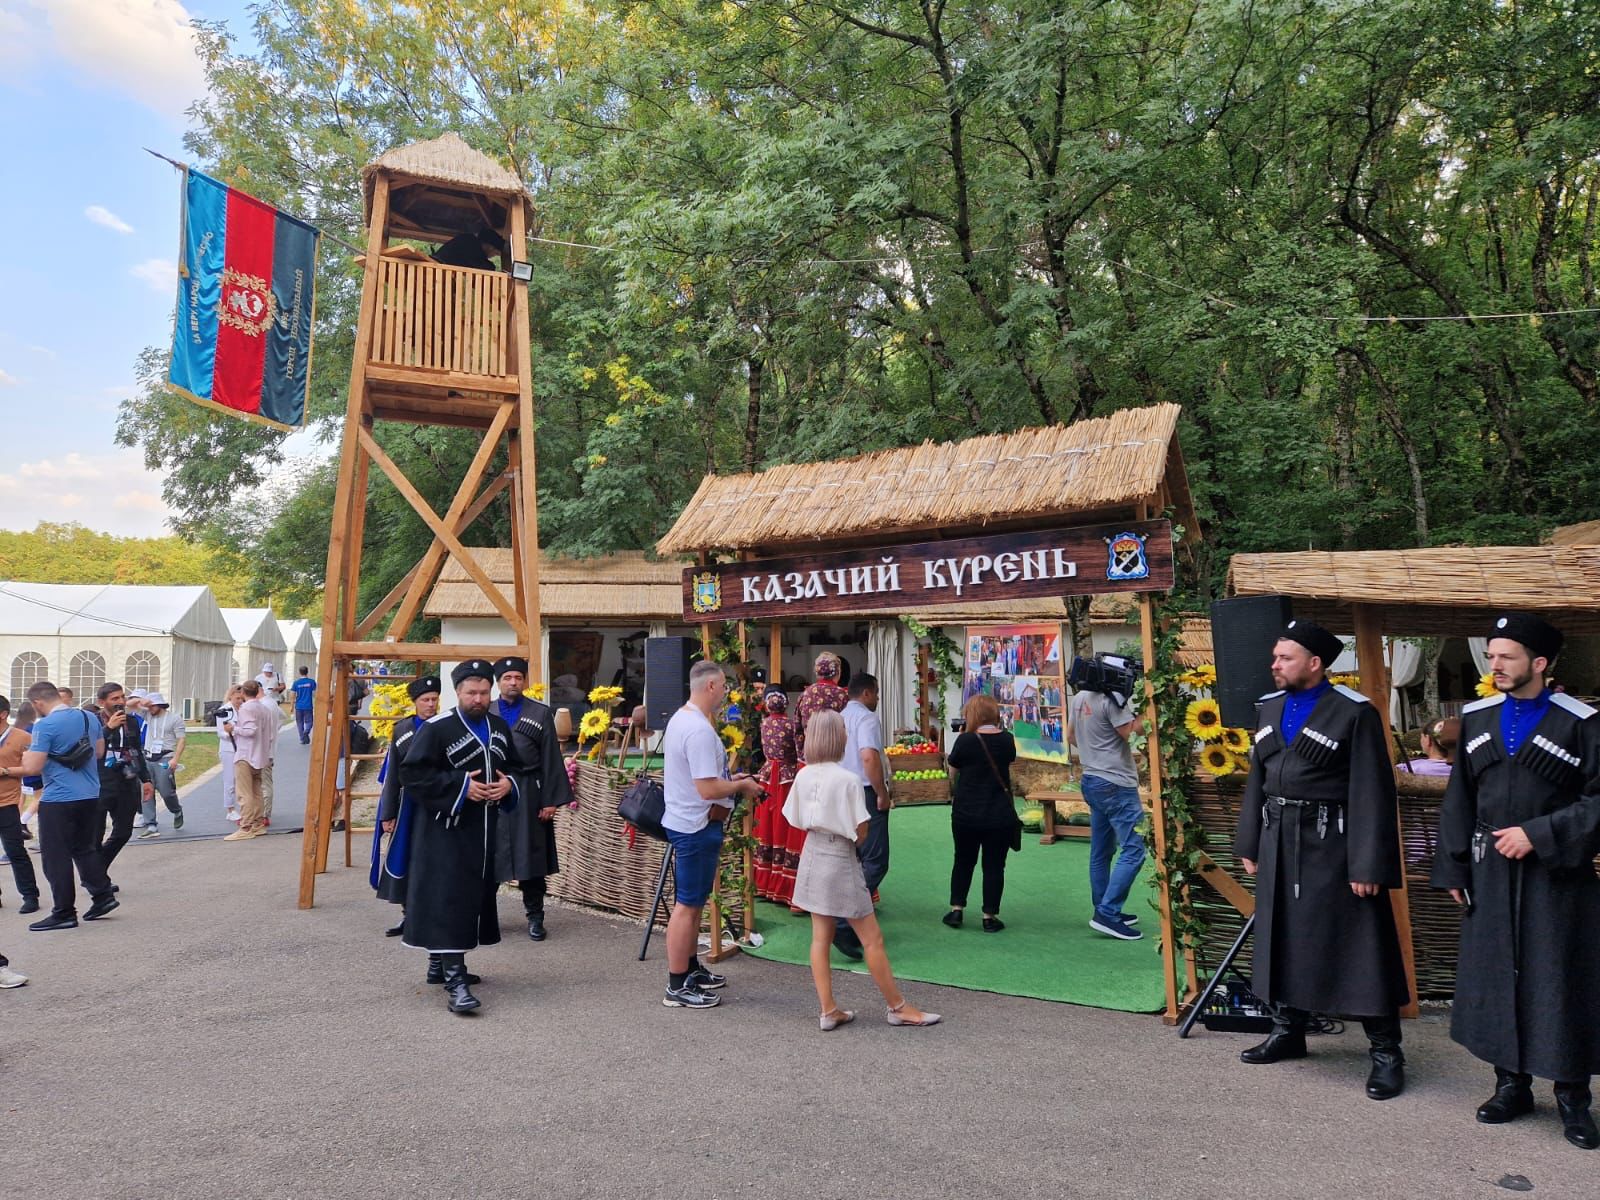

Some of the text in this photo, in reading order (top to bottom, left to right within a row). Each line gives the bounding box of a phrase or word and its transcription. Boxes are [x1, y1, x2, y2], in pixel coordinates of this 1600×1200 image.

[285, 346, 297, 380] ГОРОД
[741, 548, 1077, 603] КАЗАЧИЙ КУРЕНЬ
